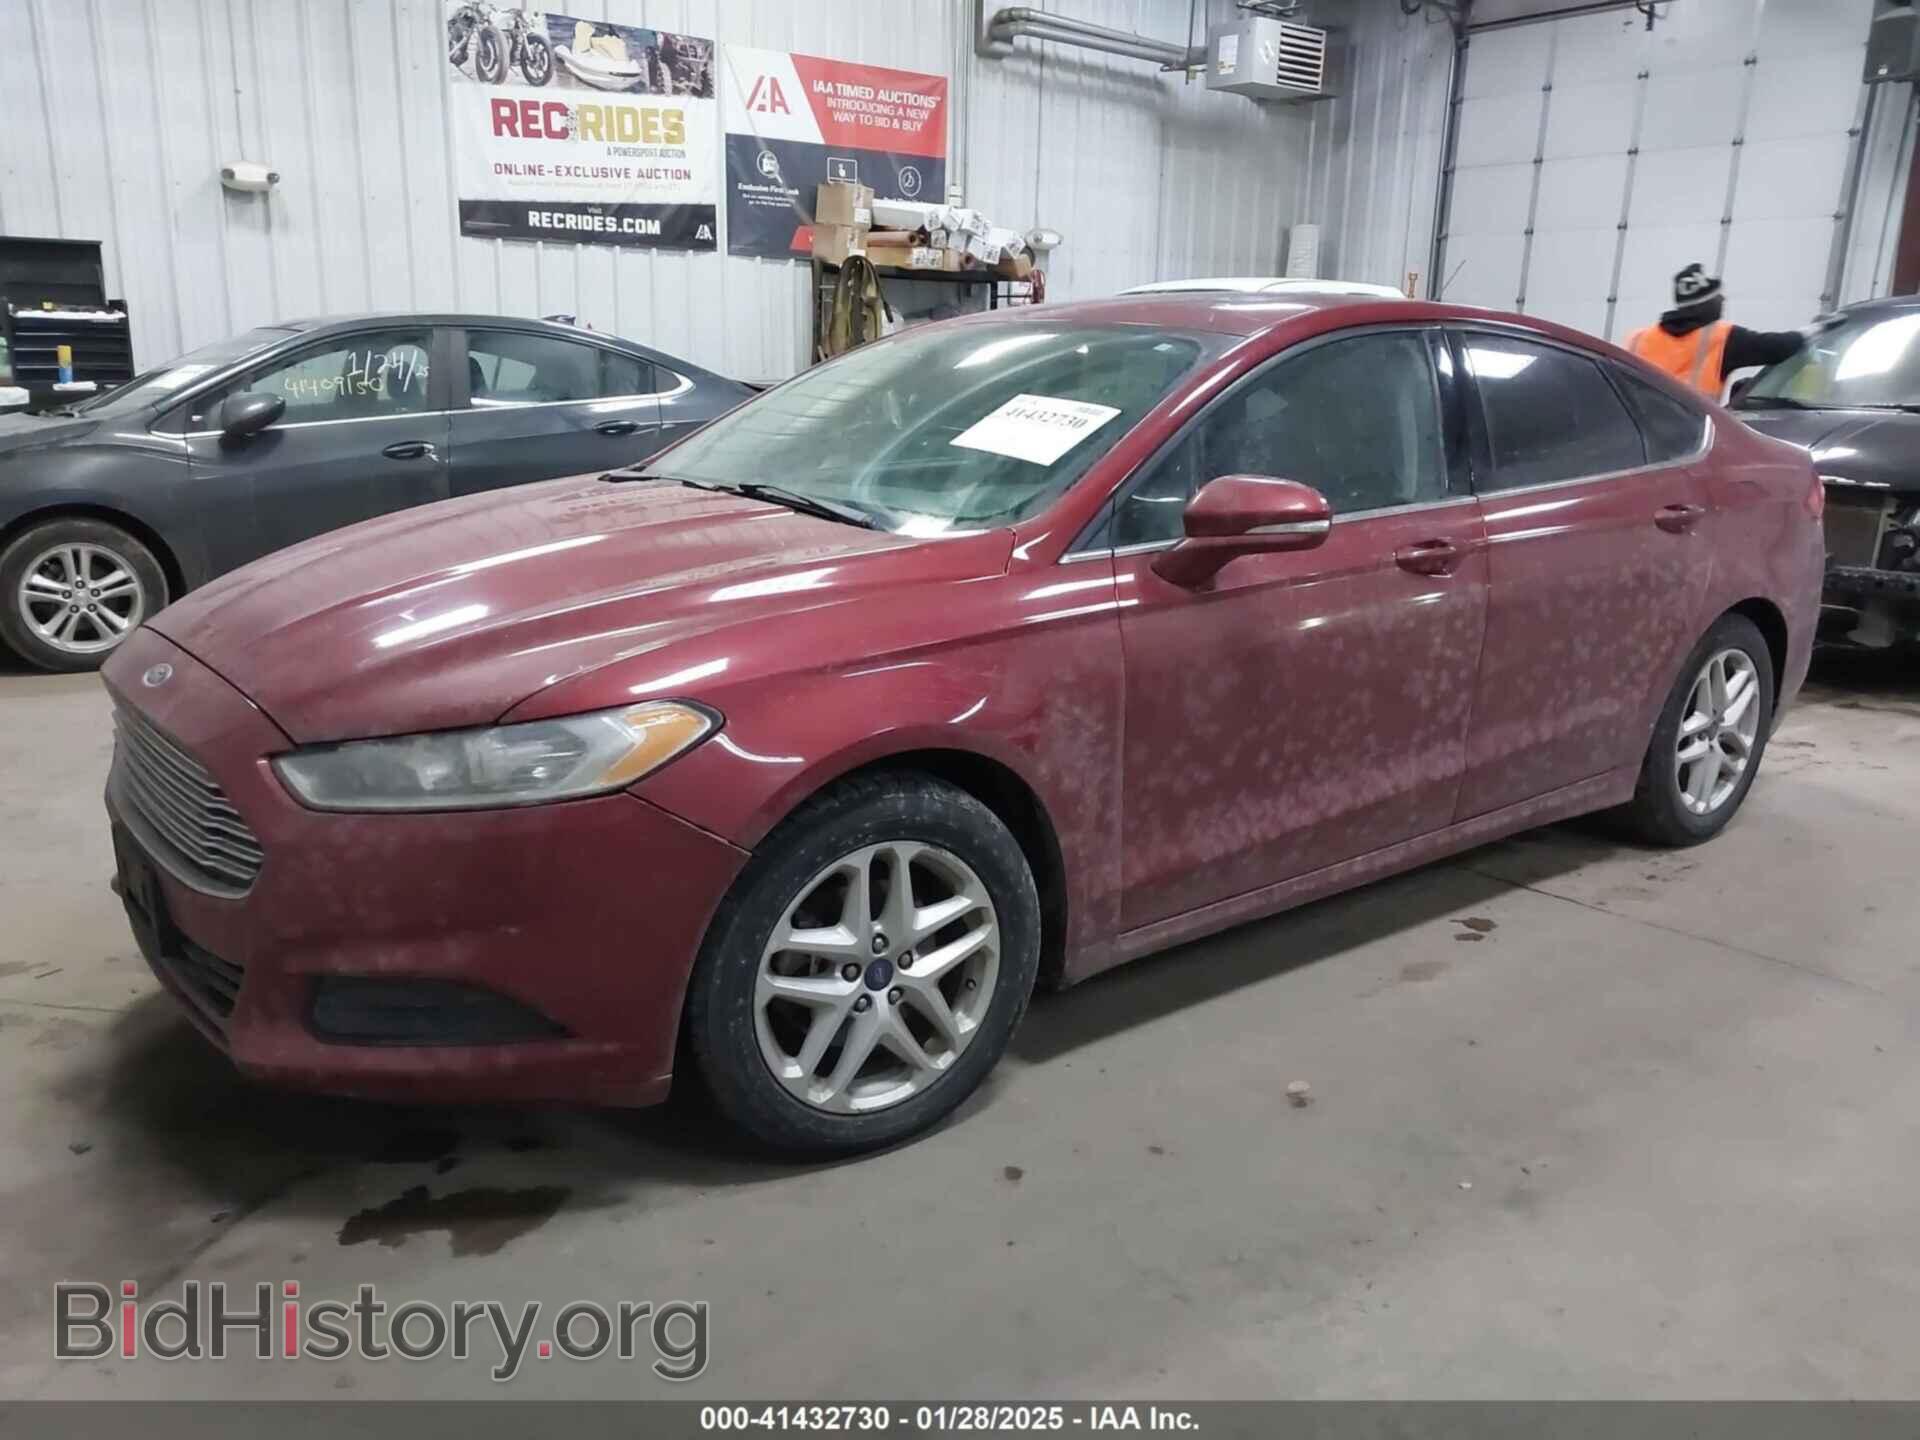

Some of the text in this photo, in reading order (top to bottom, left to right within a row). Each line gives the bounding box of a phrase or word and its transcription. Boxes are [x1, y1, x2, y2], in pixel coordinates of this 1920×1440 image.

[813, 80, 834, 95] IAA
[837, 83, 874, 100] TIMED
[827, 97, 929, 120] INTRODUCING A NEW
[490, 98, 686, 145] REC RIDES
[833, 111, 923, 132] WAY TO BID & BUY
[494, 163, 692, 180] ONLINE-EXCLUSIVE AUCTION
[528, 211, 661, 235] RECRIDES.COM
